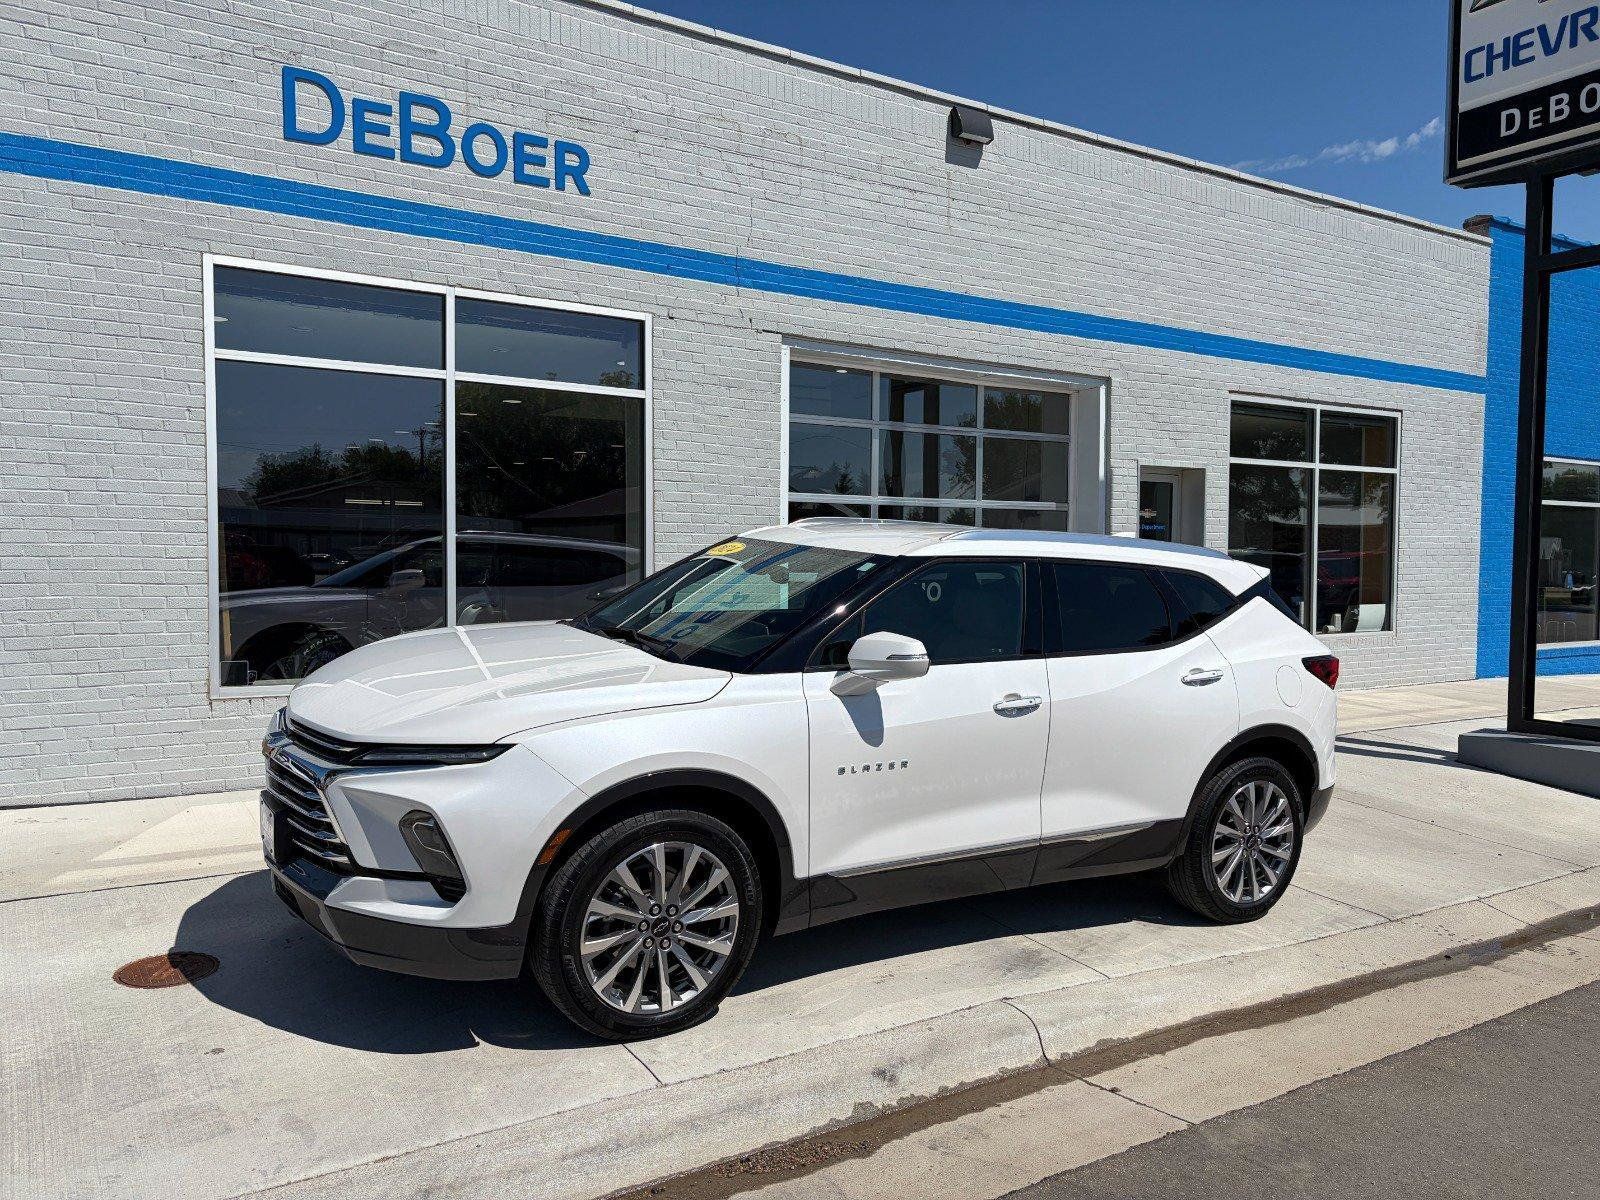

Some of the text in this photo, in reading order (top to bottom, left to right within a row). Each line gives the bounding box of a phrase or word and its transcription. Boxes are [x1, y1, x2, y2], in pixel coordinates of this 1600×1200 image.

[1464, 5, 1600, 84] CHEVR
[281, 65, 591, 196] DEBOER
[837, 760, 909, 776] BLAZER
